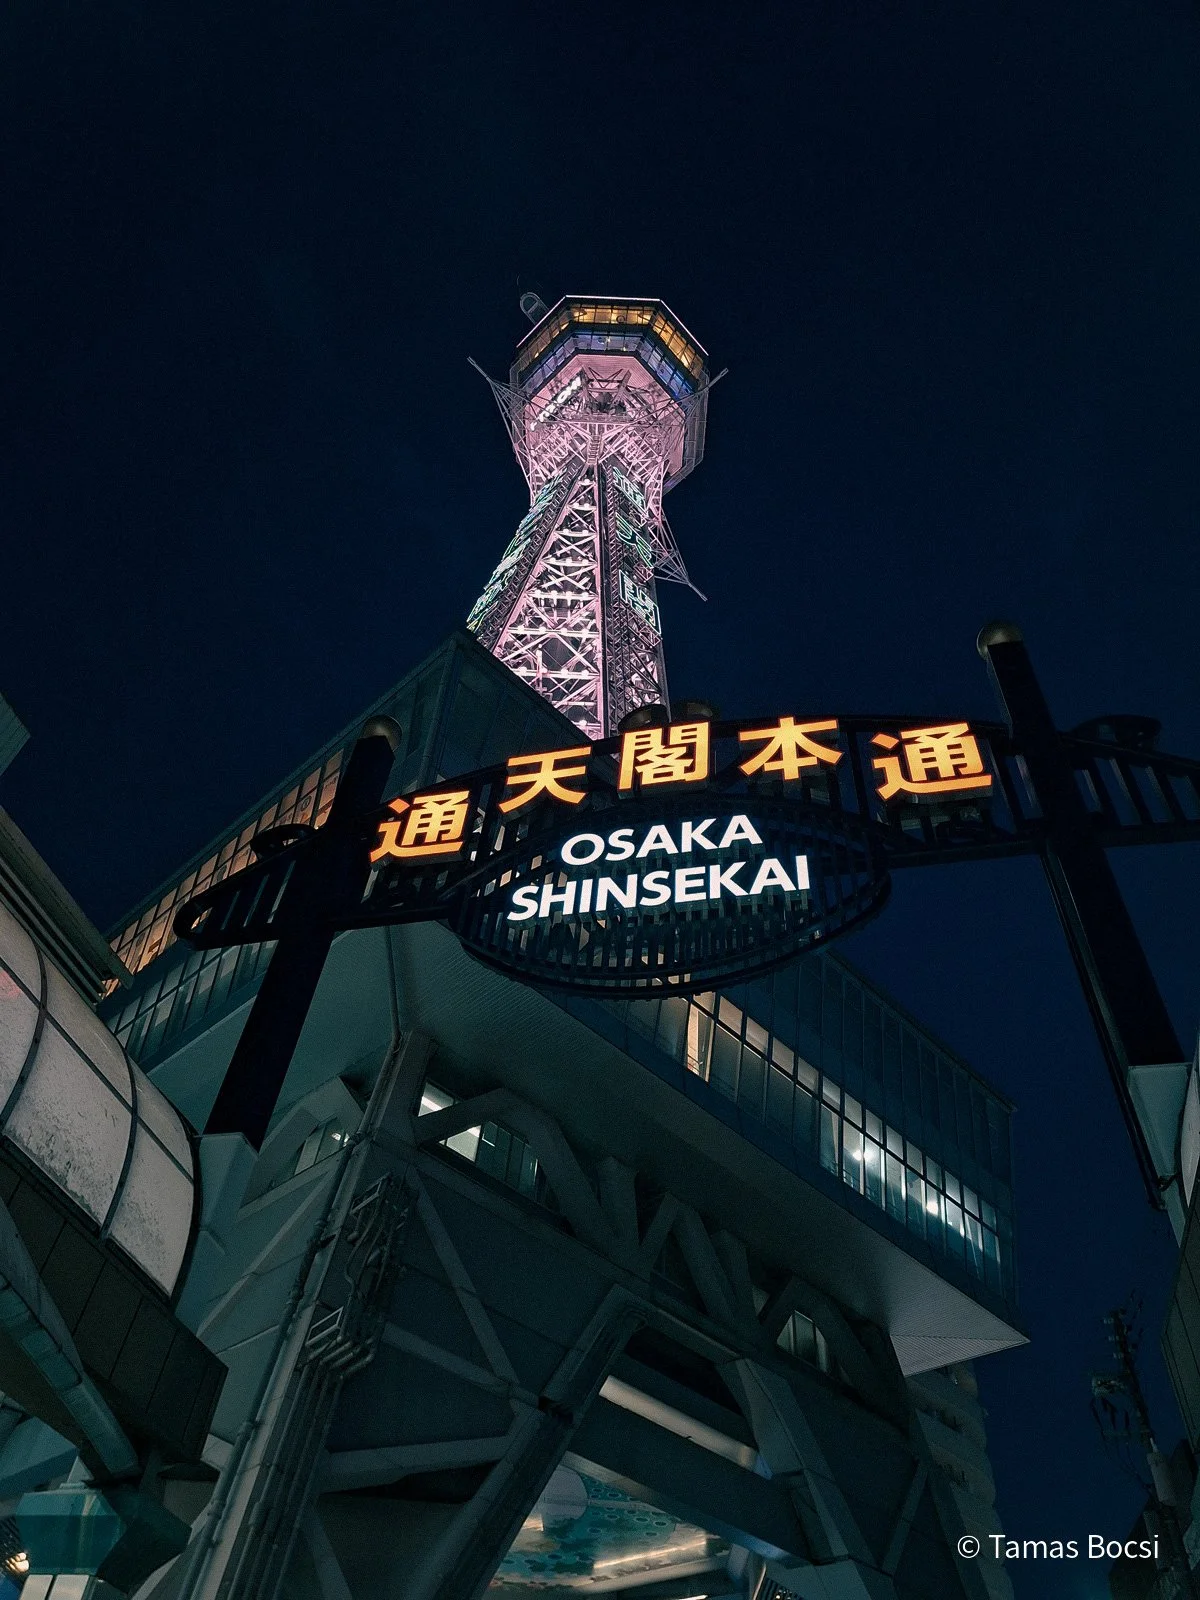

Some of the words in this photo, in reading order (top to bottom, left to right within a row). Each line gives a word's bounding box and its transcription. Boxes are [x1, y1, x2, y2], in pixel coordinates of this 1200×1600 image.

[370, 715, 993, 864] 通天閣本通
[561, 814, 763, 866] OSAKA
[506, 855, 810, 921] SHINSEKAI
